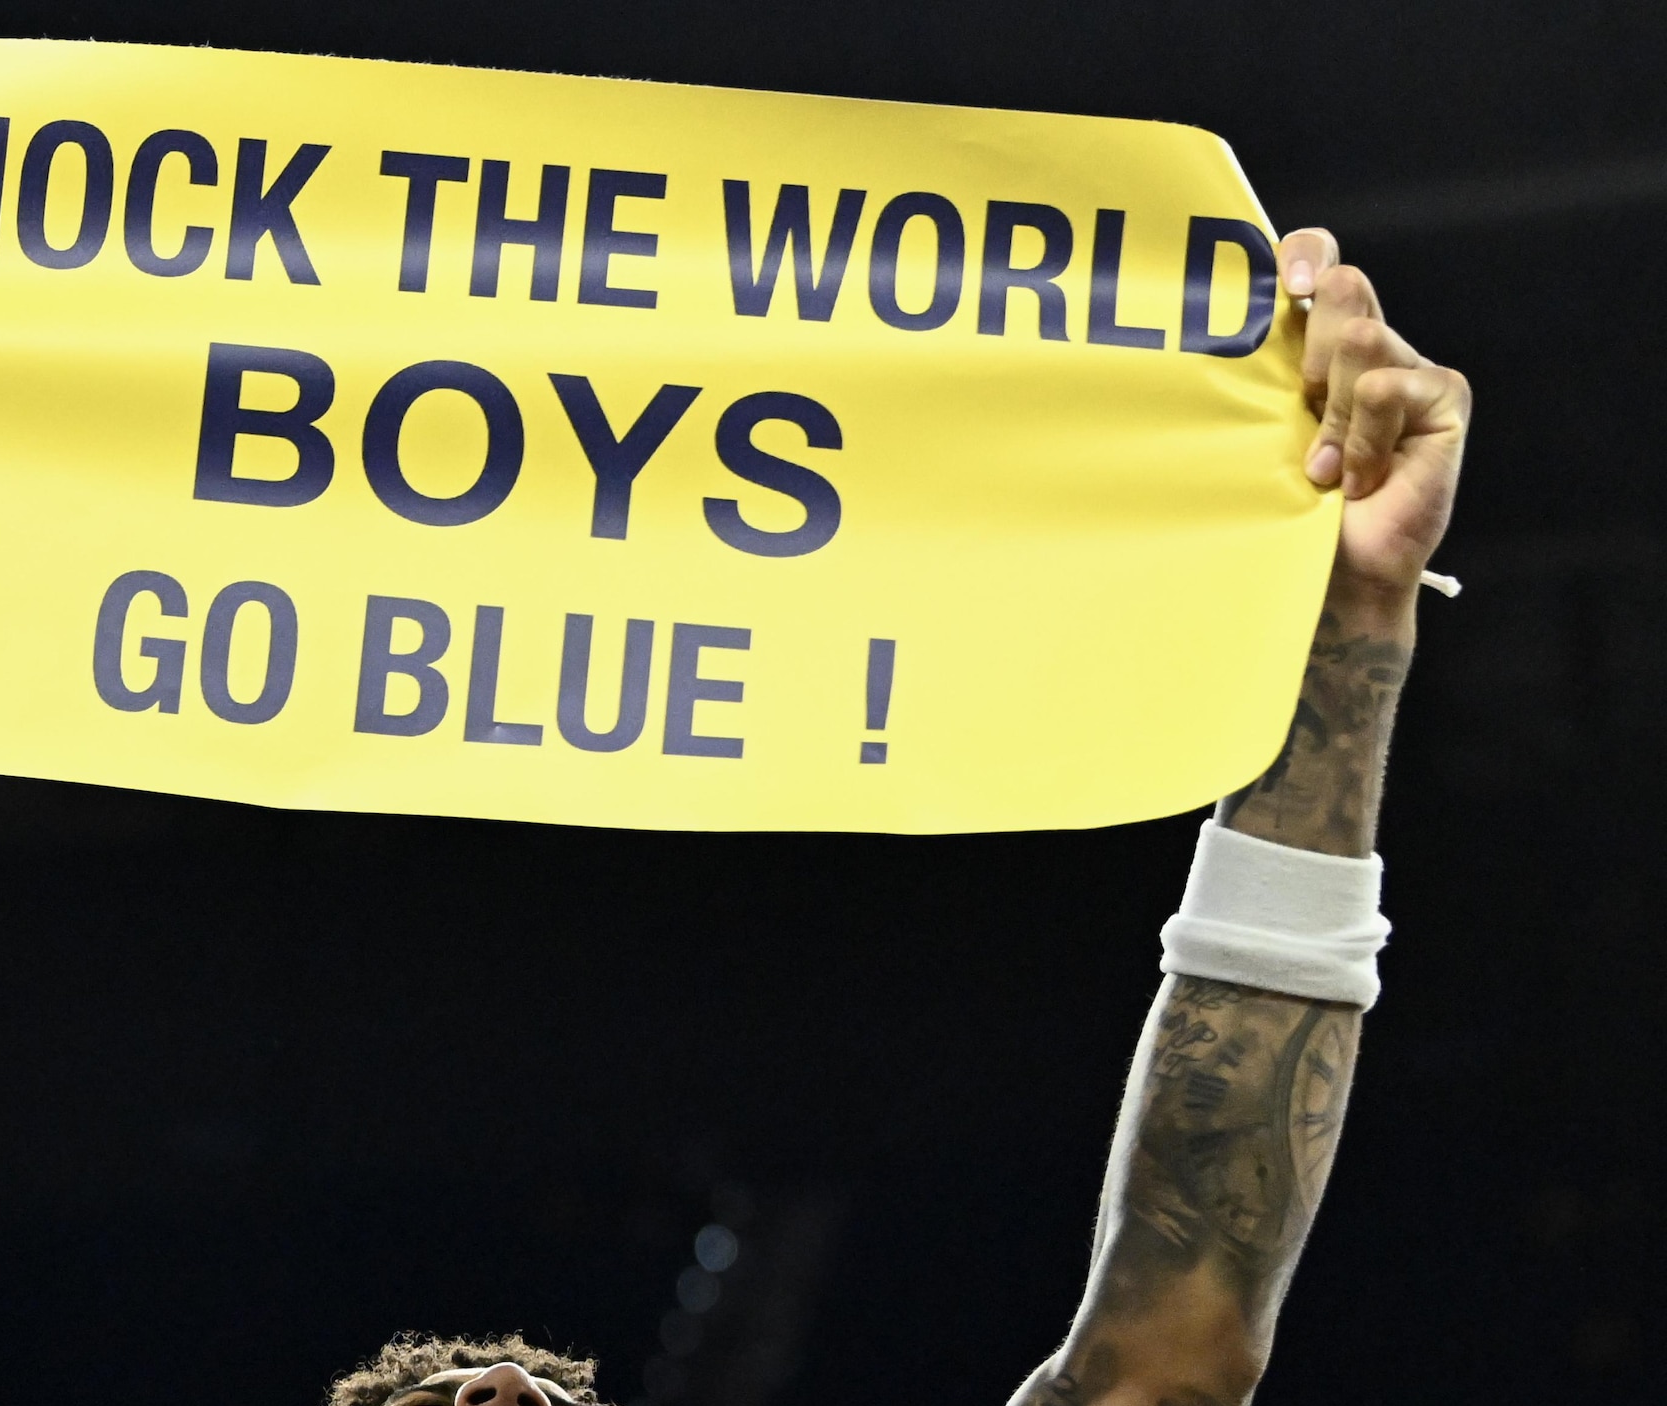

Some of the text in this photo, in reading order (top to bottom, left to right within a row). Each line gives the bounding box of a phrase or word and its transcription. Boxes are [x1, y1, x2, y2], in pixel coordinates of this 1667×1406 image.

[380, 150, 671, 310] THE
[723, 179, 1278, 358] WORLD
[193, 340, 845, 560] BOYS
[91, 568, 899, 767] GO BLUE !
